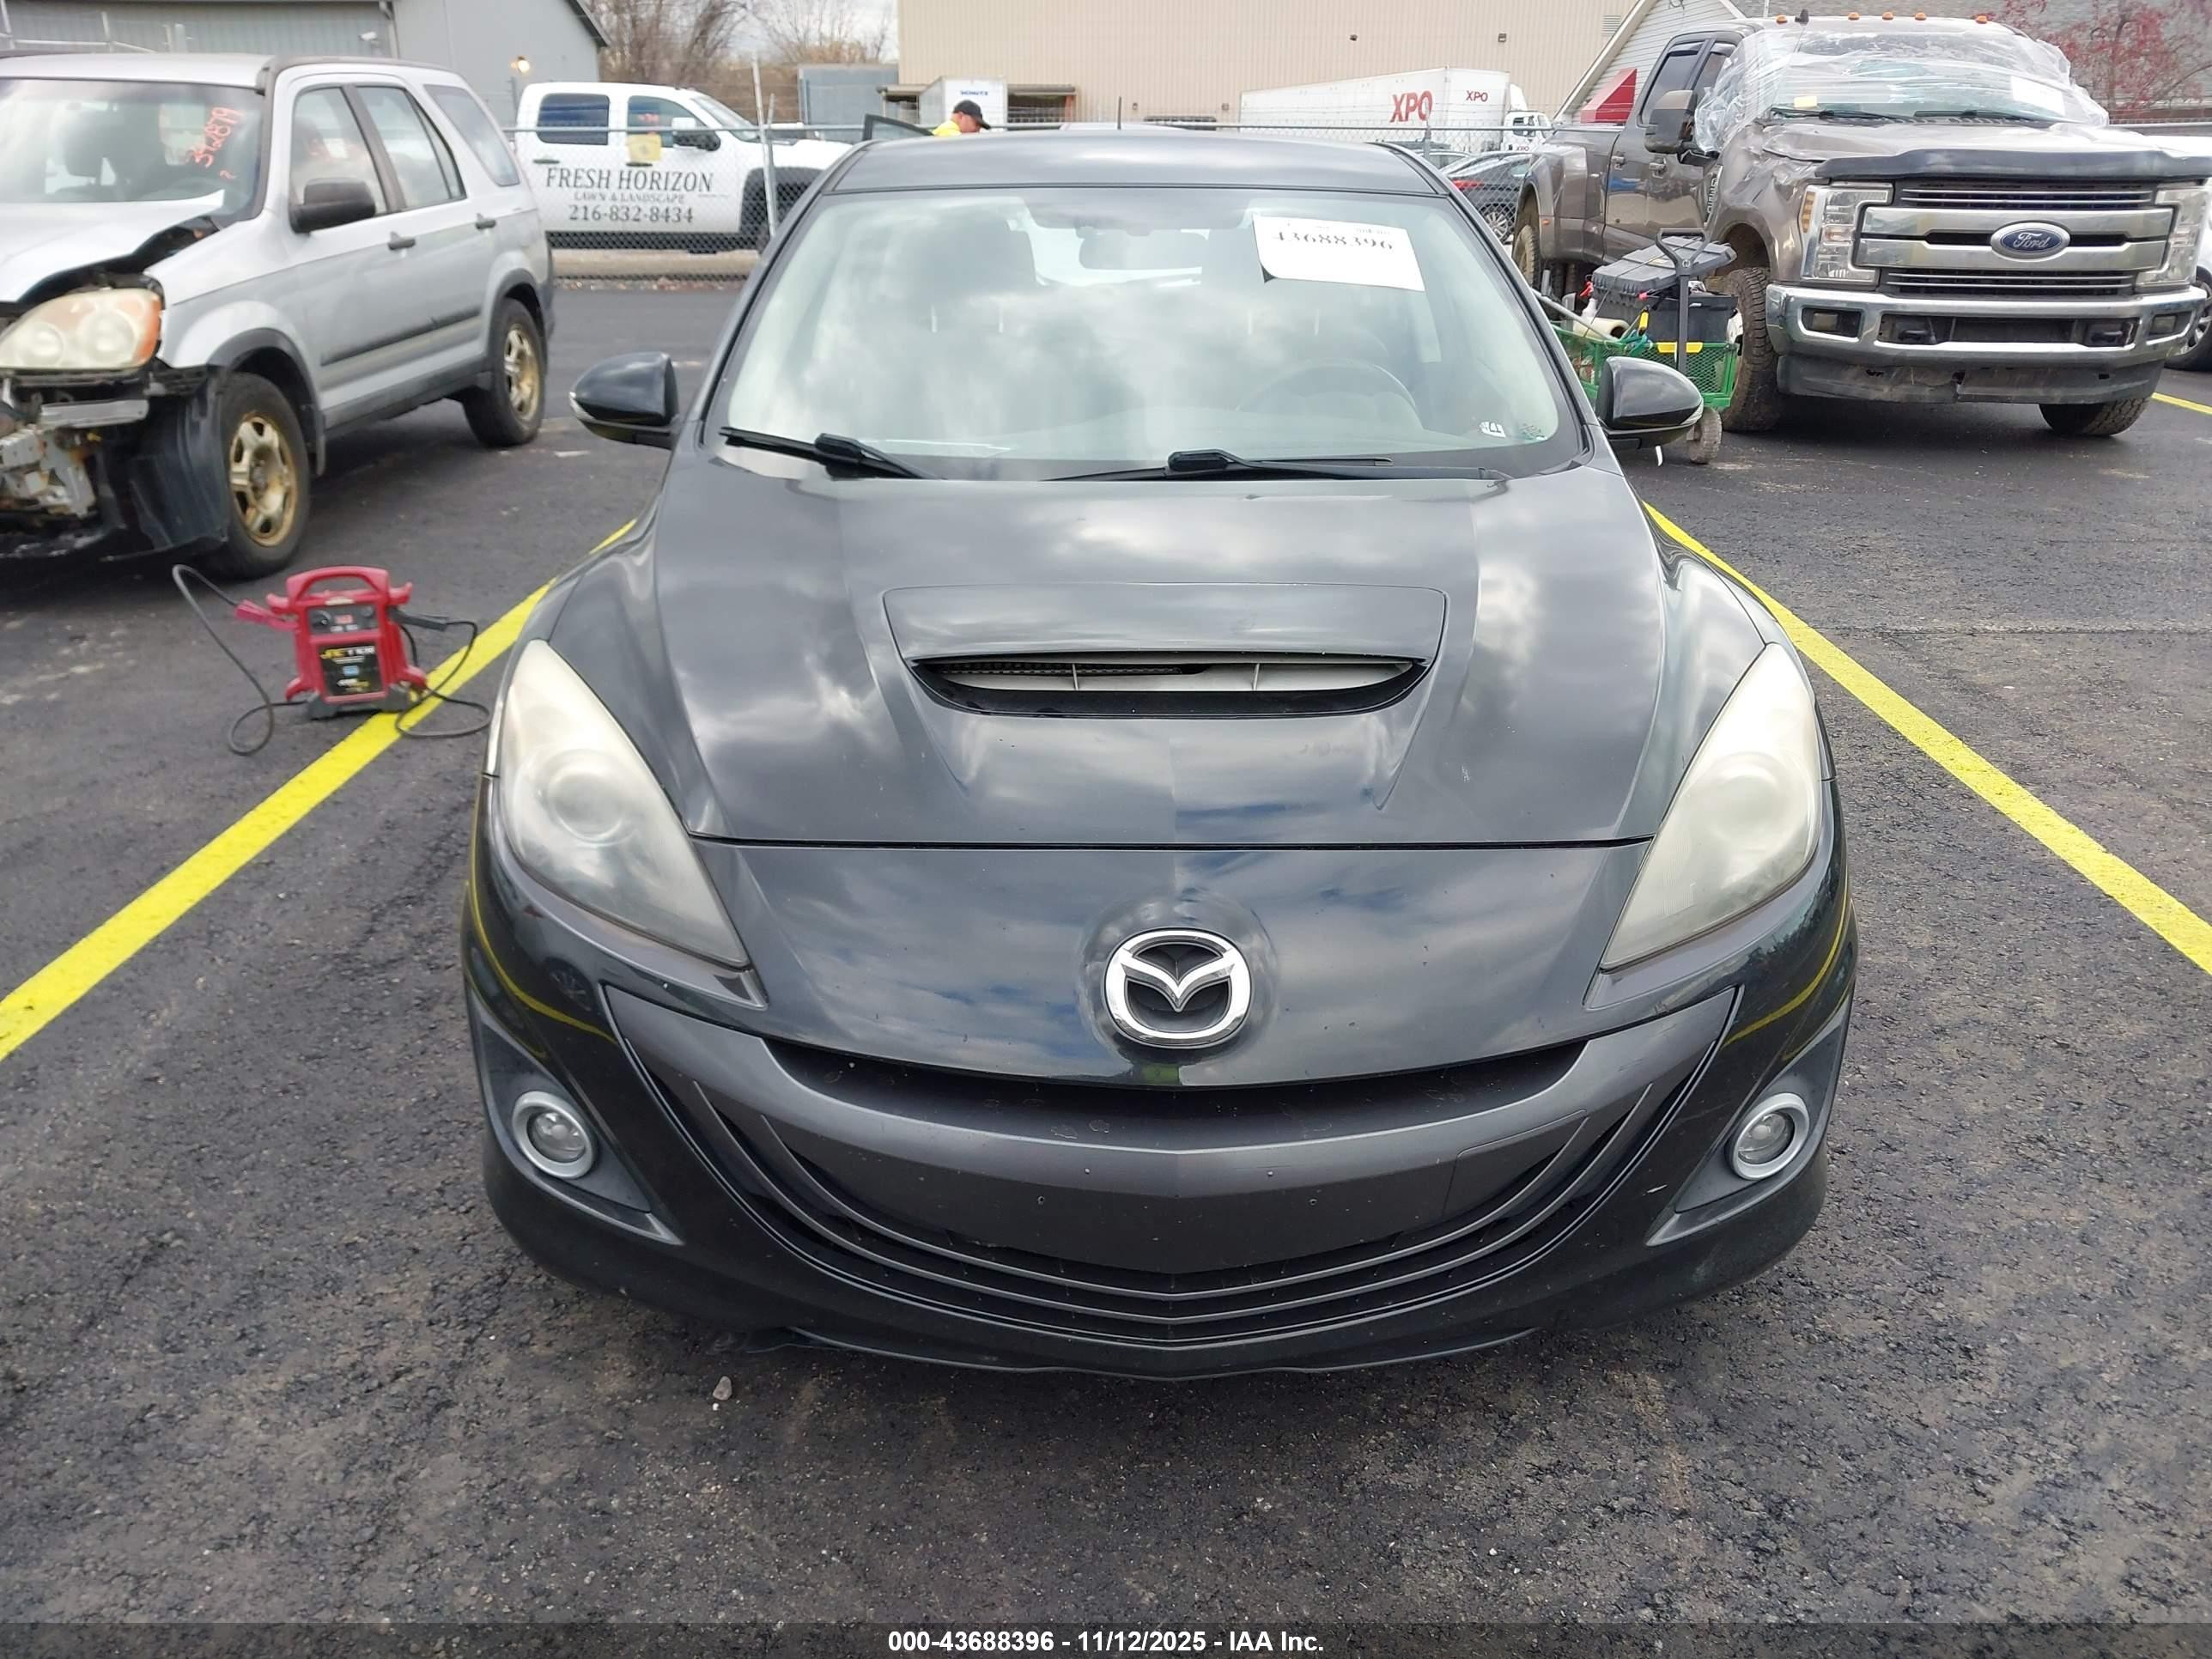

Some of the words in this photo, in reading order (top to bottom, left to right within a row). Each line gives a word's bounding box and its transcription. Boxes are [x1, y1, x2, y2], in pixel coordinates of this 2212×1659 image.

[1466, 90, 1488, 102] XPO
[1389, 90, 1432, 123] XPO
[546, 167, 611, 190] FRESH
[618, 170, 714, 192] HORIZON
[574, 191, 606, 201] LAWN
[620, 193, 684, 204] LANDSCAPE
[568, 204, 694, 223] 216-832-8434
[2013, 232, 2051, 247] Ford
